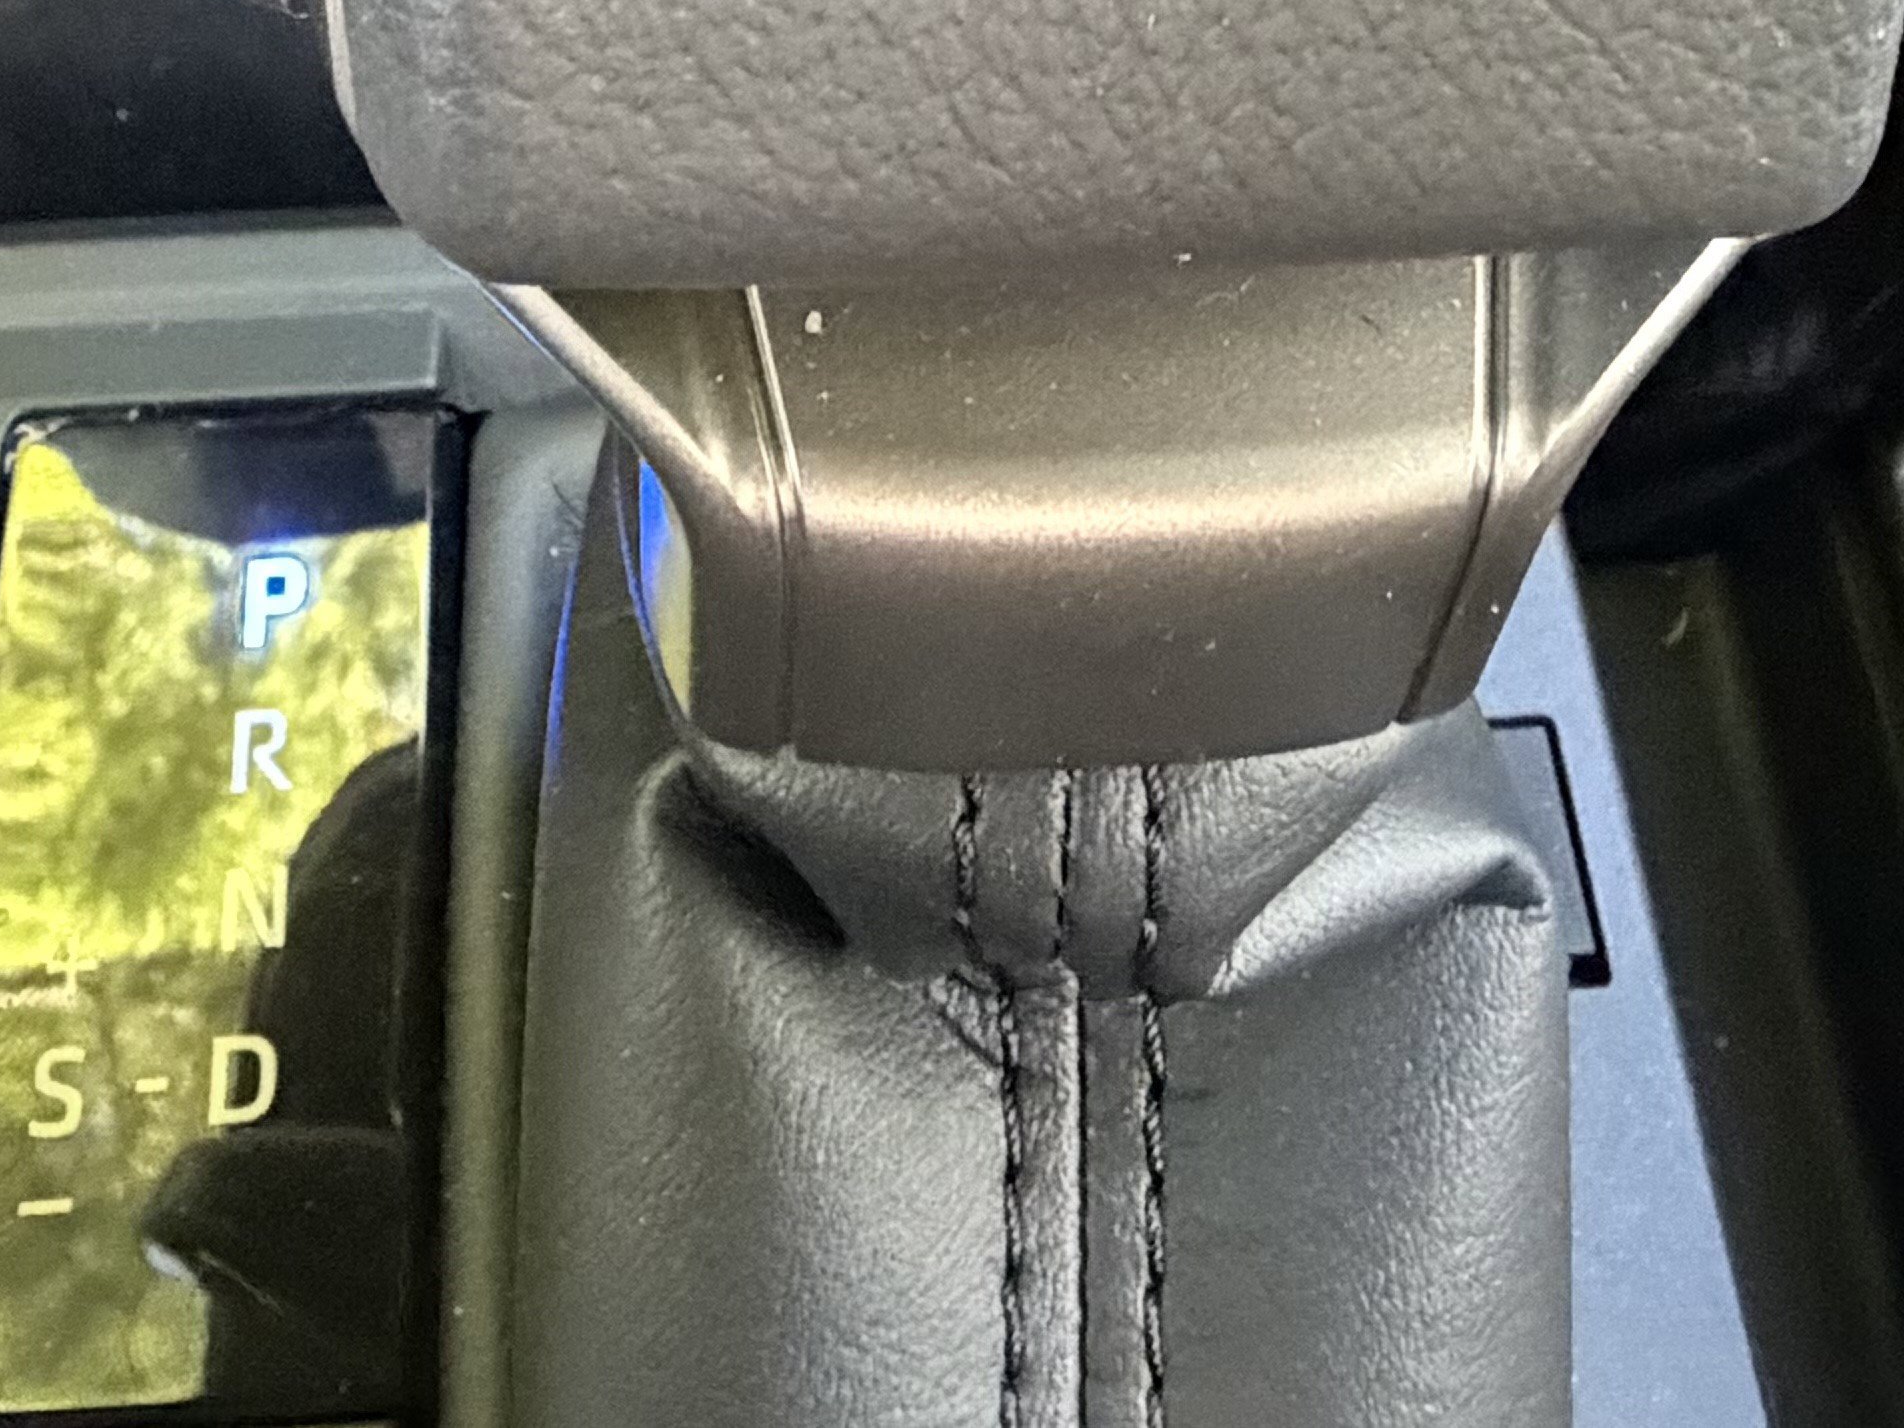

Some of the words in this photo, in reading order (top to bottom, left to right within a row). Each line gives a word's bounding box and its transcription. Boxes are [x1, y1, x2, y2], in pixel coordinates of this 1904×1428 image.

[240, 553, 312, 650] P
[229, 708, 292, 794] R
[219, 863, 289, 952] N
